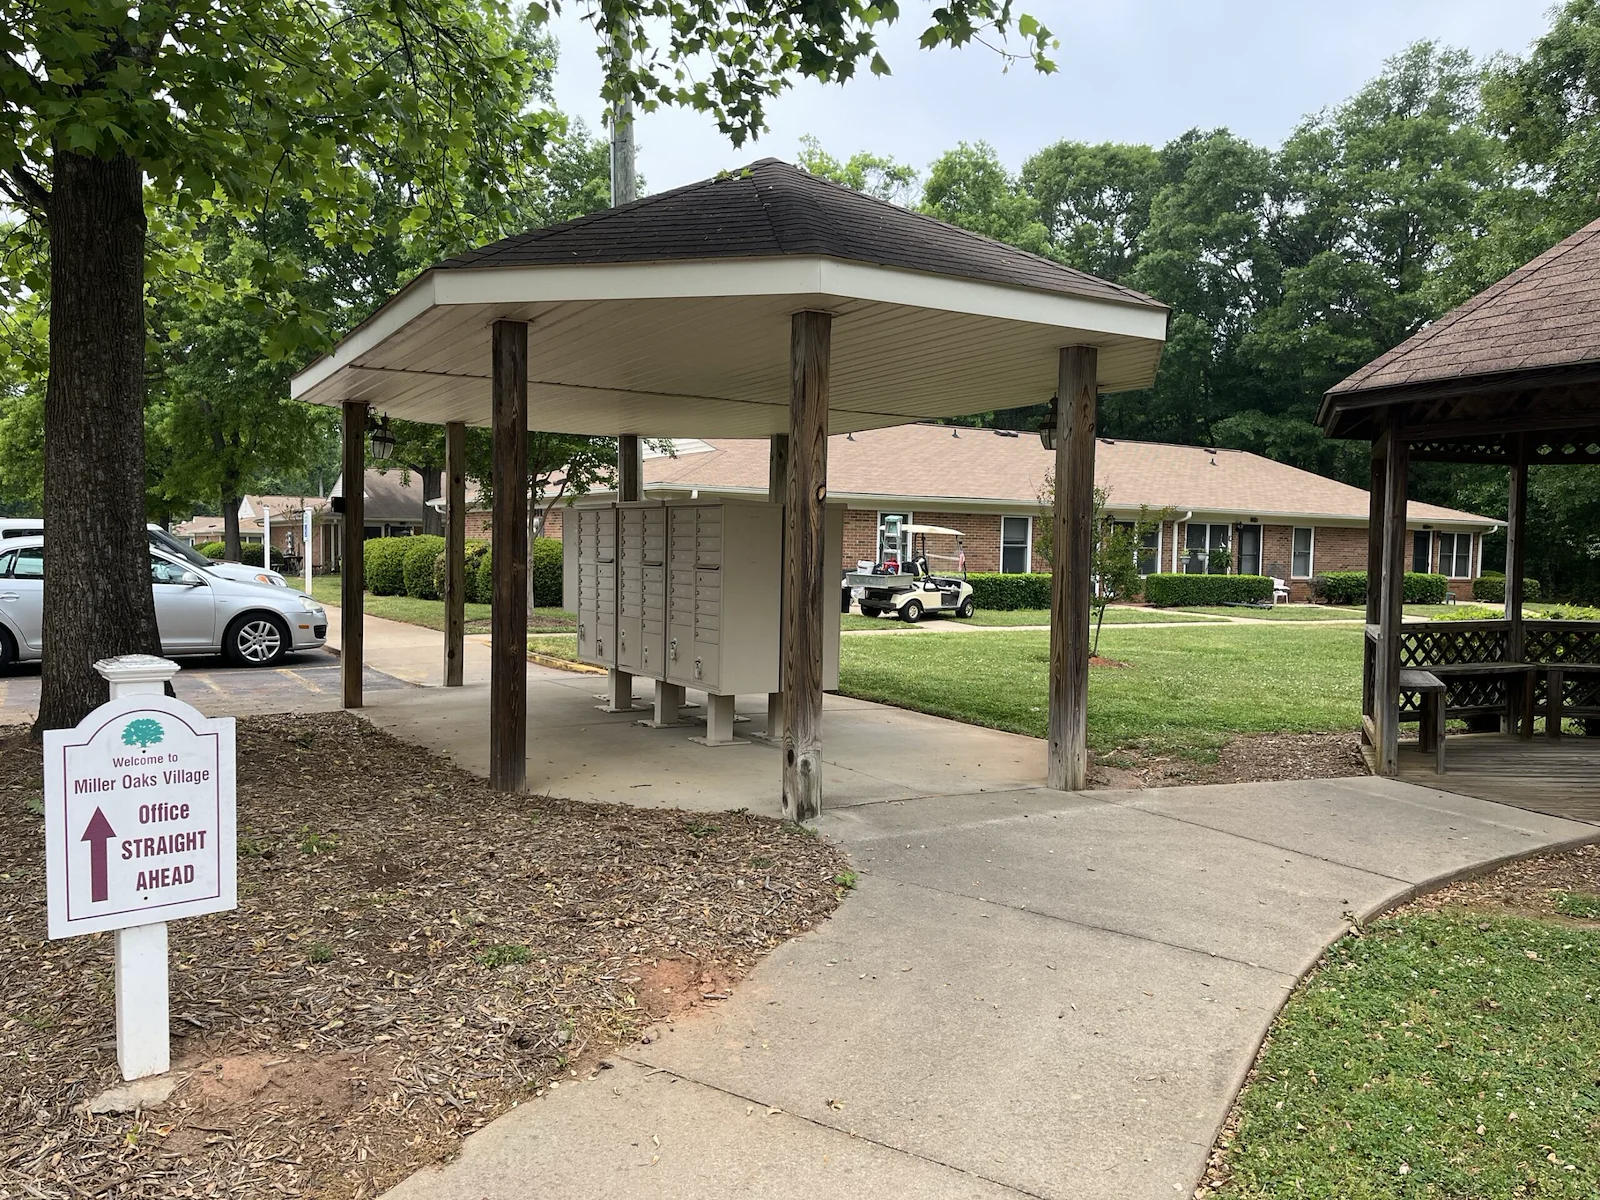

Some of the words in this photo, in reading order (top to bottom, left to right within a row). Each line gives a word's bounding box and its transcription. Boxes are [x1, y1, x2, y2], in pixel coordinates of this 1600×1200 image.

[113, 755, 164, 768] Welcome
[168, 753, 179, 763] to
[75, 777, 117, 794] Miller
[122, 773, 158, 790] Oaks
[163, 768, 210, 785] Village
[139, 803, 190, 825] Office
[121, 830, 207, 860] STRAIGHT
[136, 865, 195, 892] AHEAD
